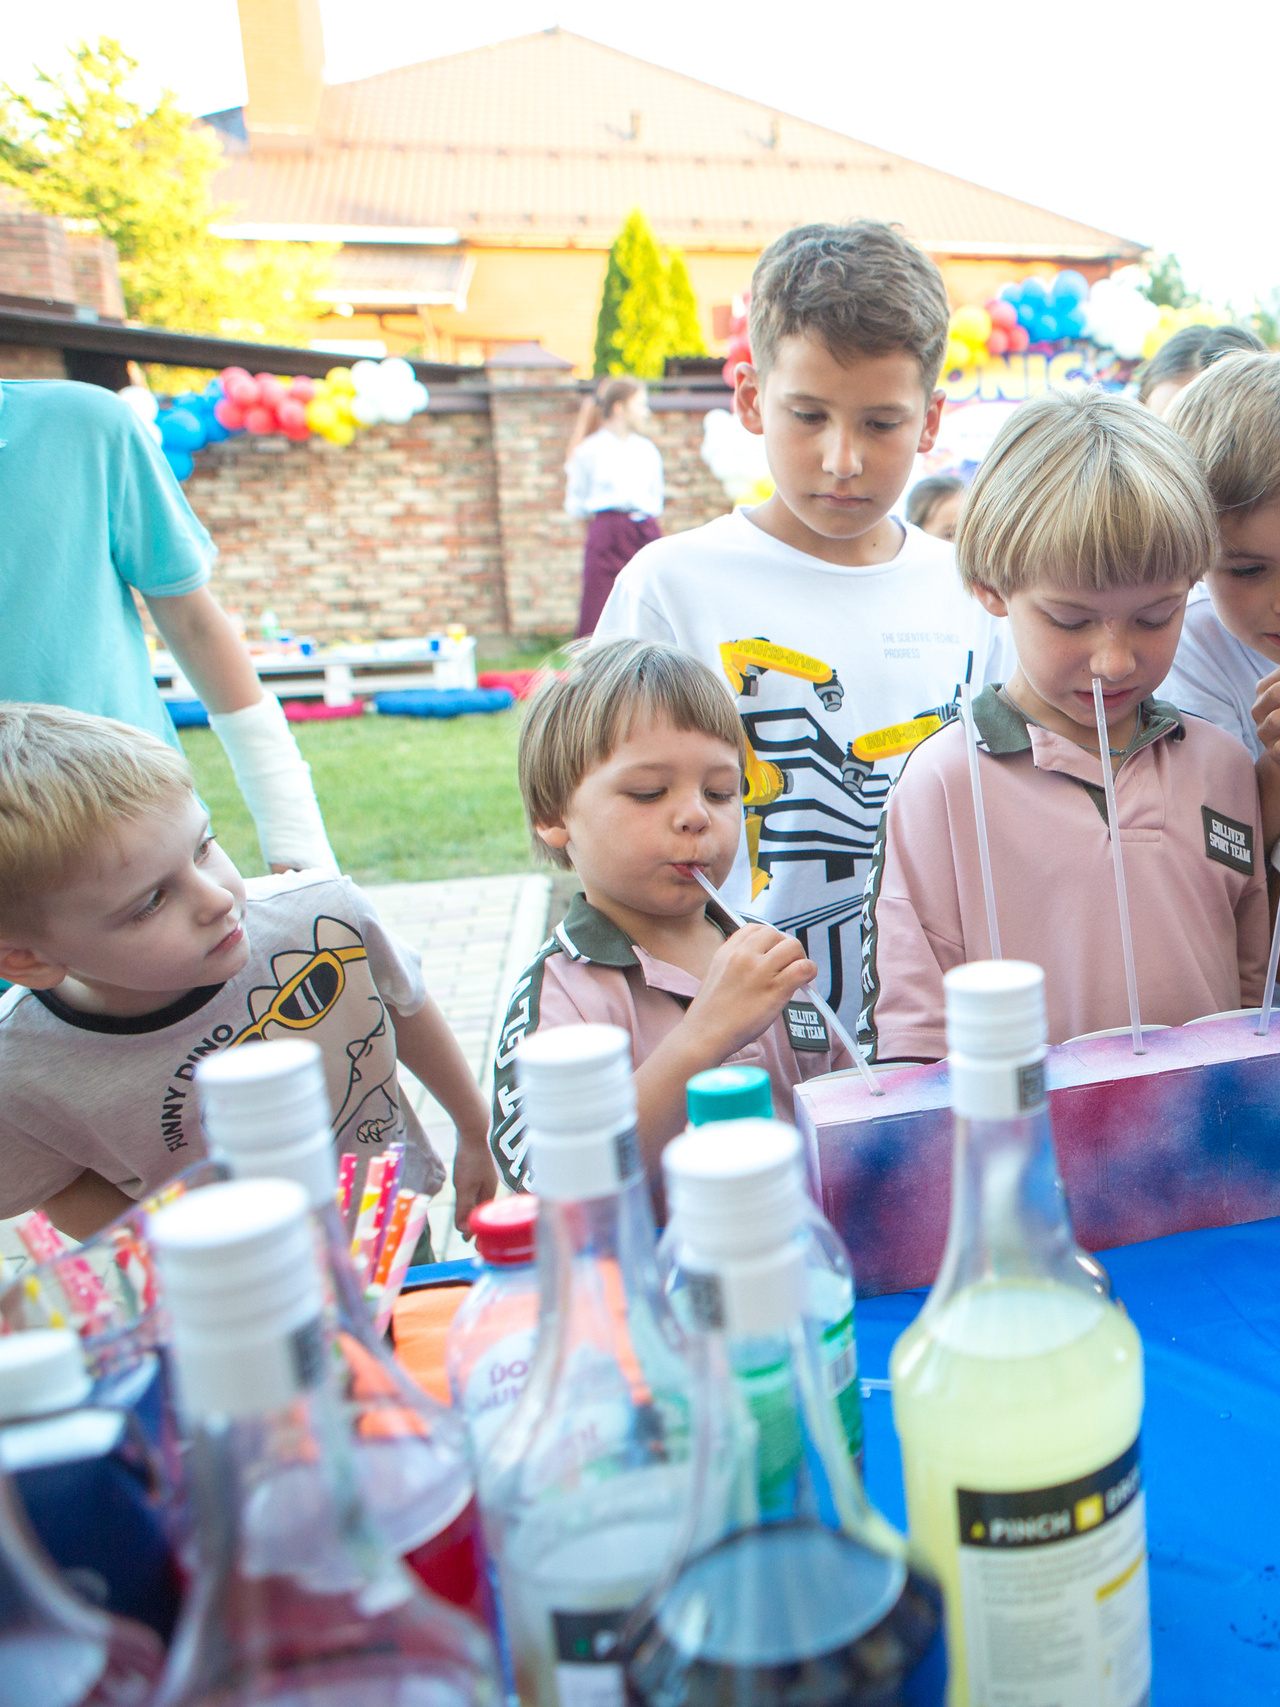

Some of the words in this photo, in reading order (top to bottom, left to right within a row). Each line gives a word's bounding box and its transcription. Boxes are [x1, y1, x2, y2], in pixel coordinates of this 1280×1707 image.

[934, 352, 1092, 402] ONIC
[881, 632, 895, 643] THE
[883, 648, 920, 659] PROGRESS
[1211, 818, 1246, 847] GULLIVER
[1209, 832, 1230, 855] SPORT
[1230, 842, 1252, 864] TEAM
[787, 1008, 820, 1025] GULLIVER
[788, 1022, 807, 1039] SPORT
[805, 1025, 827, 1040] TEAM
[173, 1024, 234, 1082] DINO
[160, 1085, 189, 1153] FUNNY
[989, 1509, 1072, 1544] PINCH
